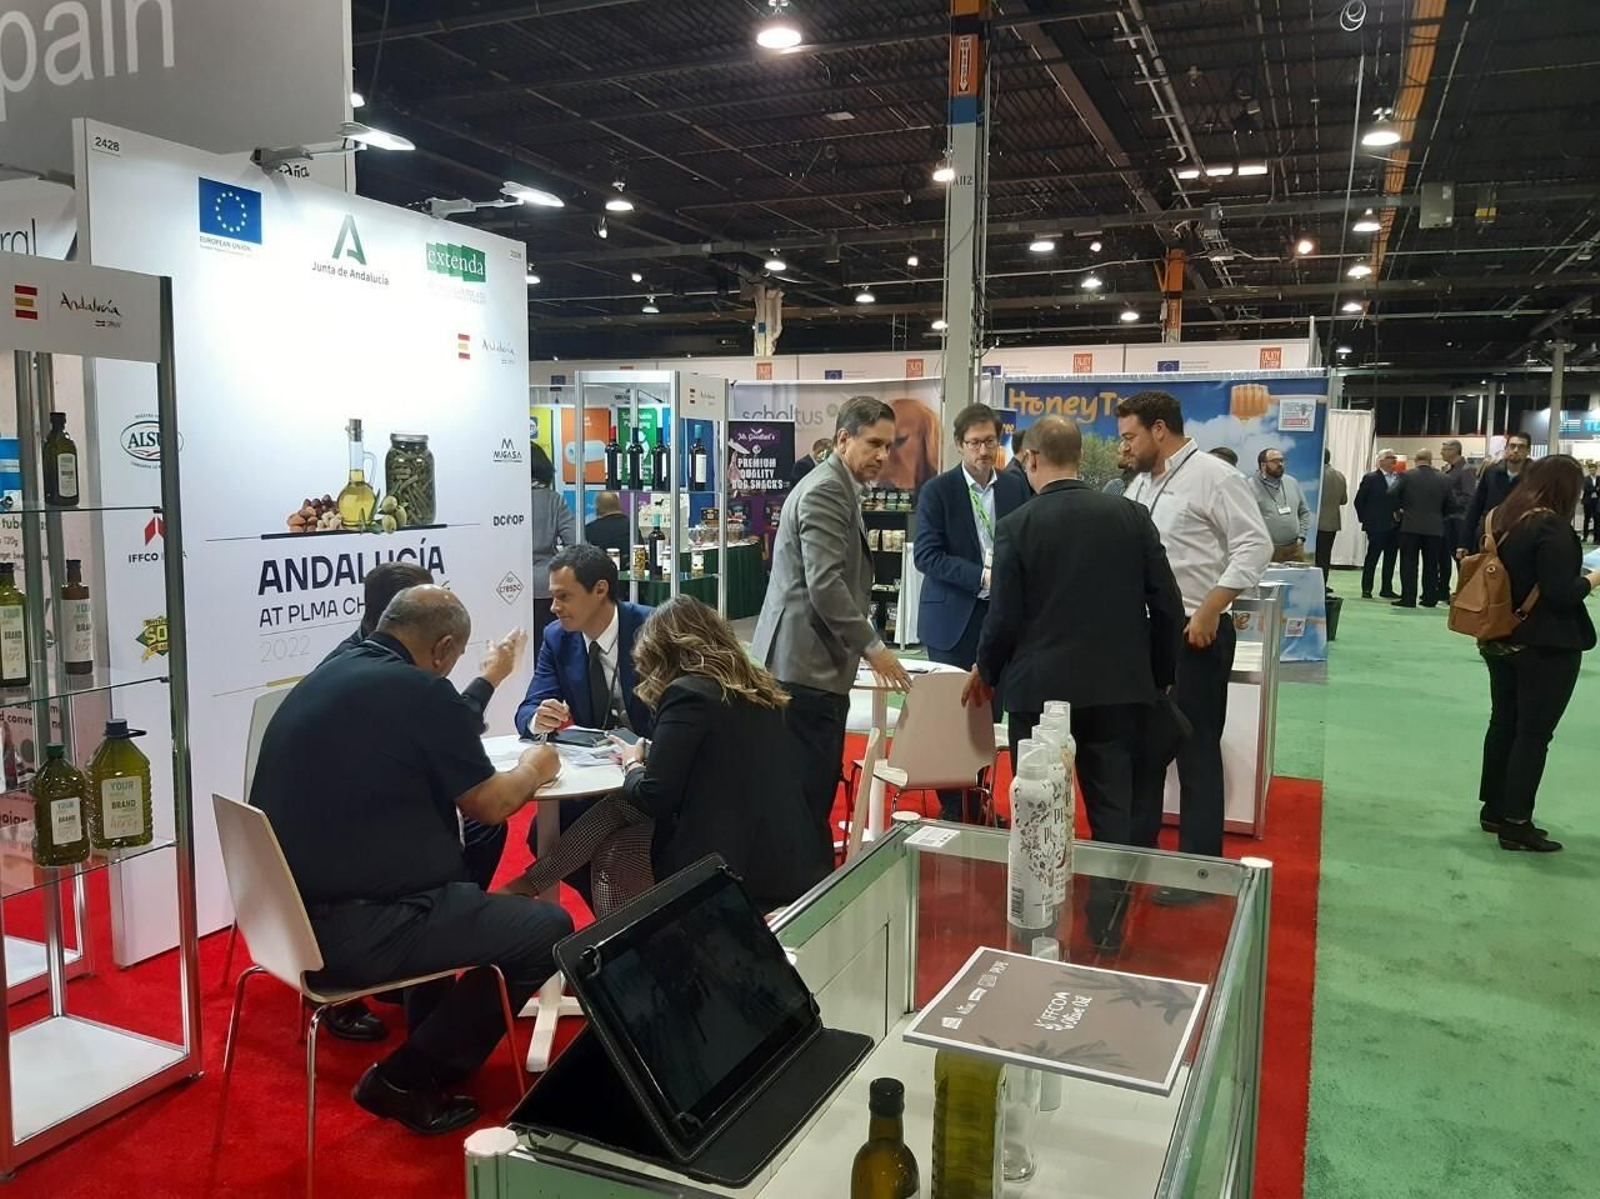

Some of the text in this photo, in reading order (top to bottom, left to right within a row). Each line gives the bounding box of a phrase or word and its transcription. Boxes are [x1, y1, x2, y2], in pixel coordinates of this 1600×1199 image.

[95, 136, 120, 152] 2428
[312, 261, 336, 275] Junta
[337, 267, 348, 278] de
[427, 252, 484, 277] extenda
[742, 404, 824, 426] scholtus
[738, 458, 777, 468] PREMIUM
[740, 469, 775, 479] QUALITY
[750, 480, 783, 490] SNACKS
[128, 553, 159, 563] IFFCO
[259, 596, 365, 628] AT PLMA CH
[260, 634, 310, 663] 2022
[110, 781, 134, 791] YOUR
[112, 800, 136, 810] BRAND
